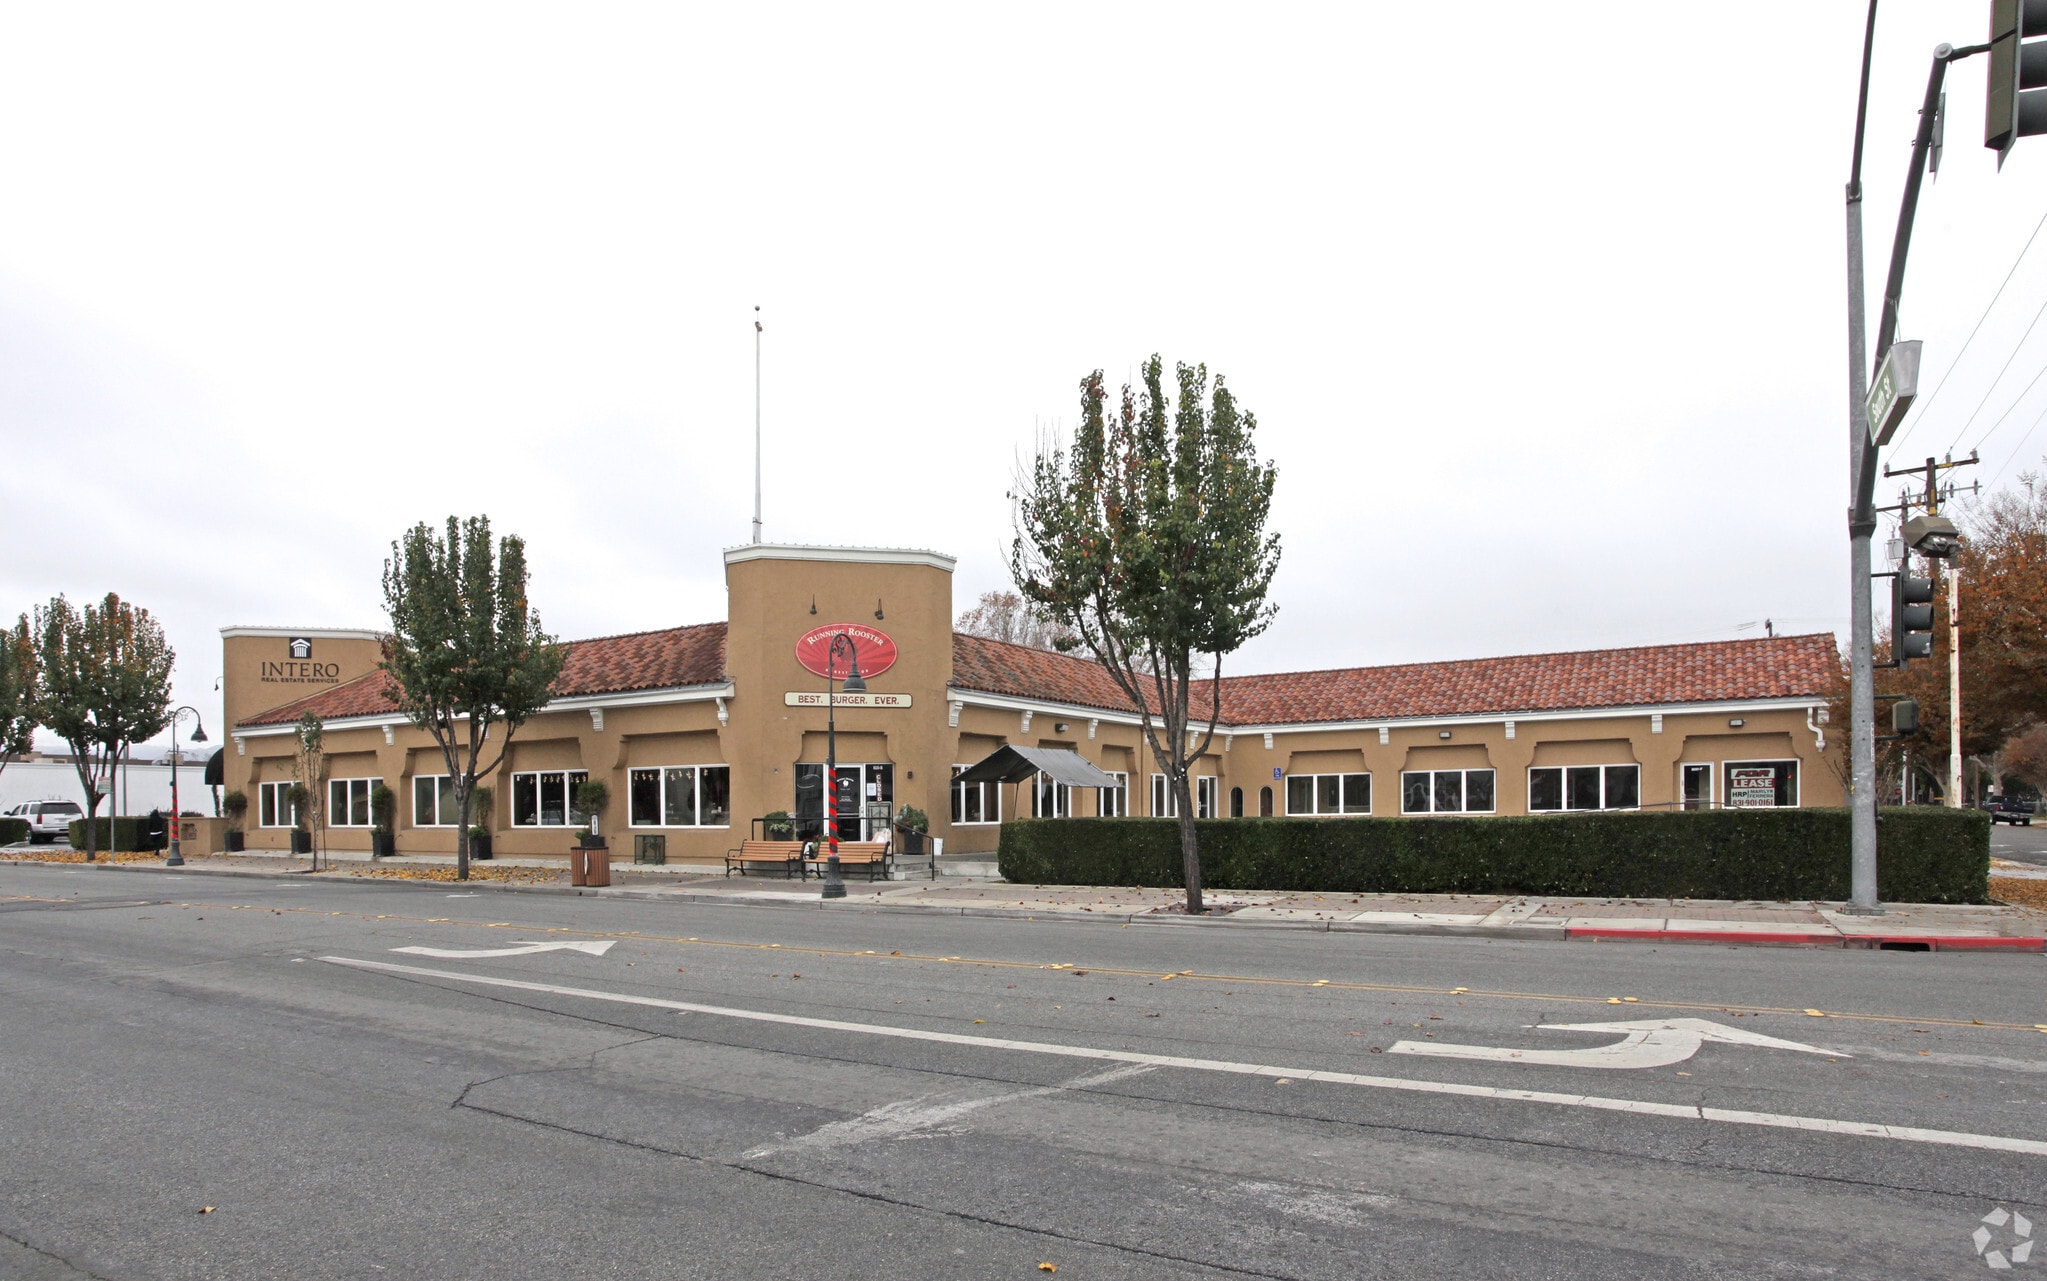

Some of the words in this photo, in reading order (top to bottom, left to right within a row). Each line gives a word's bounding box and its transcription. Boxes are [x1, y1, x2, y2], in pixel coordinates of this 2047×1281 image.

[1872, 388, 1886, 423] South
[1883, 374, 1892, 399] St
[806, 629, 844, 645] RUNNING
[848, 627, 884, 646] ROOSTER
[261, 662, 339, 677] INTERO
[798, 695, 823, 704] BEST.
[831, 696, 868, 705] BURGER.
[874, 697, 899, 705] EVER.
[1735, 769, 1770, 777] FOR
[1733, 779, 1772, 787] LEASE
